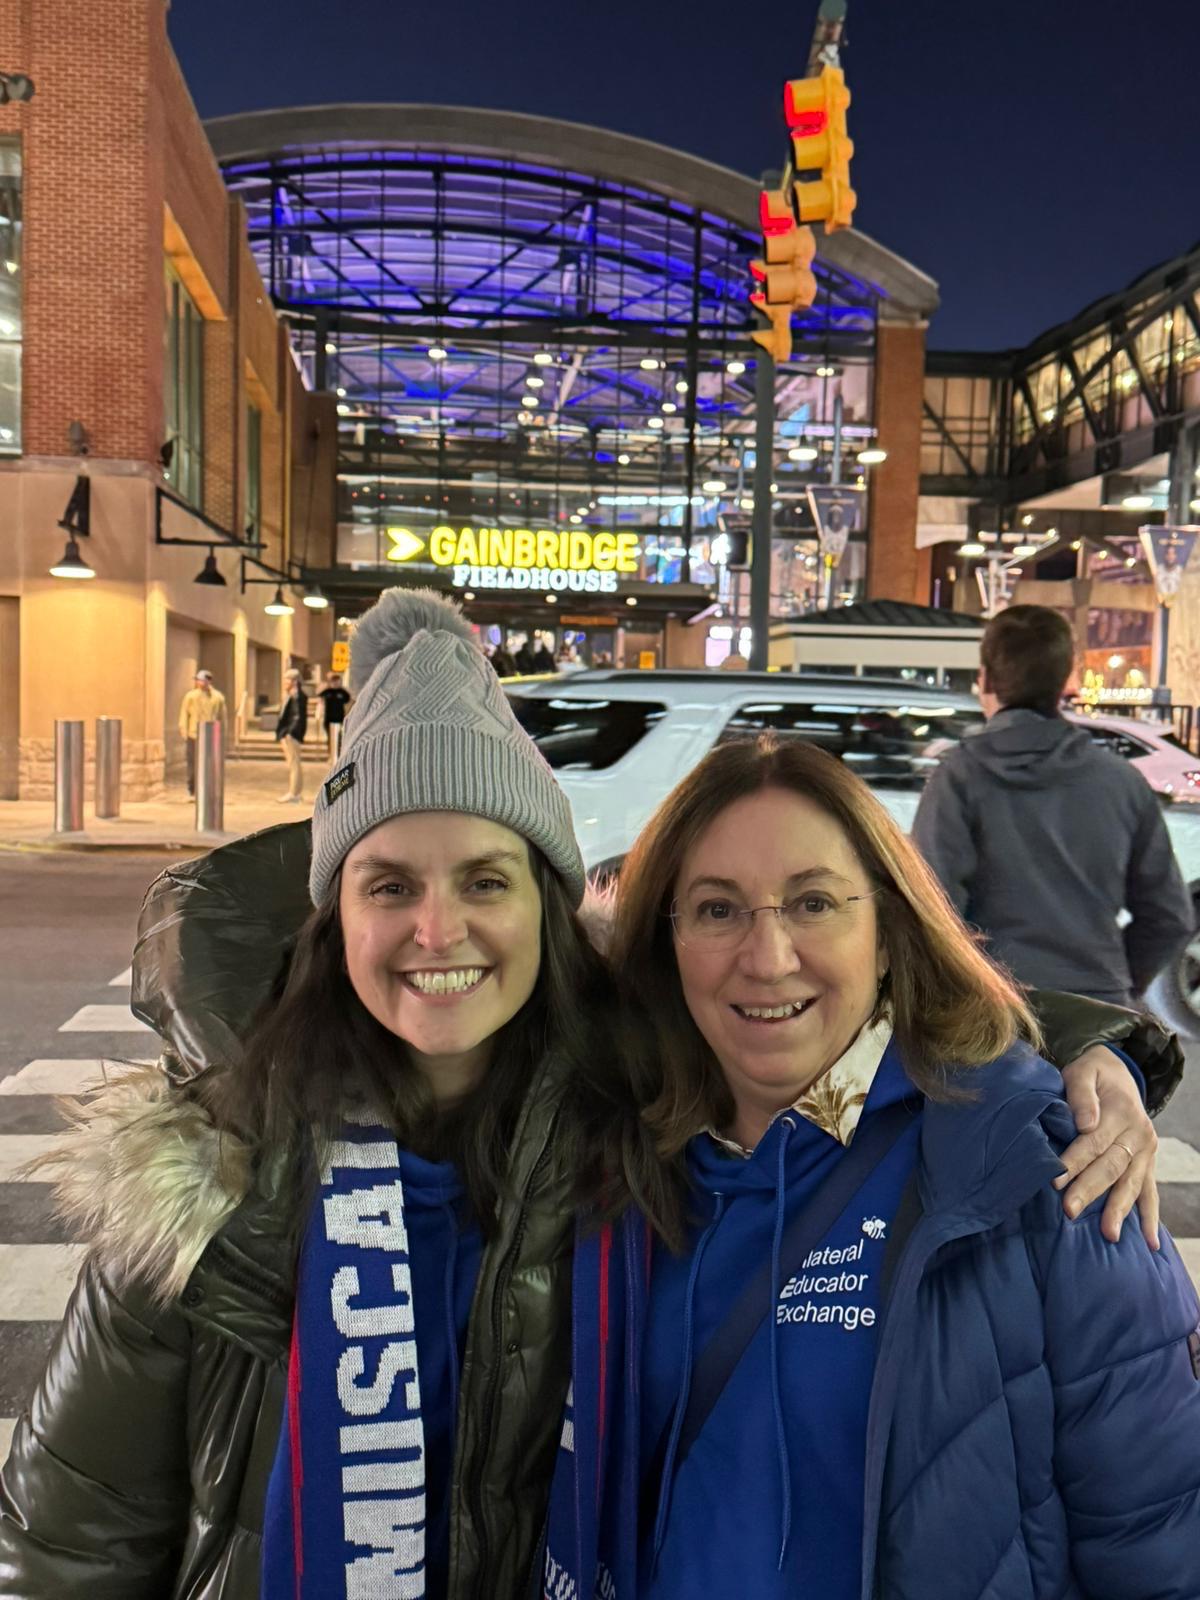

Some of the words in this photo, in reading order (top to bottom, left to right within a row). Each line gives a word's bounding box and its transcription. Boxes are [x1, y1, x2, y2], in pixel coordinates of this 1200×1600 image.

[430, 527, 638, 571] GAINBRIDGE
[453, 565, 618, 593] FIELDHOUSE
[779, 1271, 869, 1299] Educator
[776, 1301, 876, 1331] Exchange
[312, 1107, 427, 1600] MUSCAT
